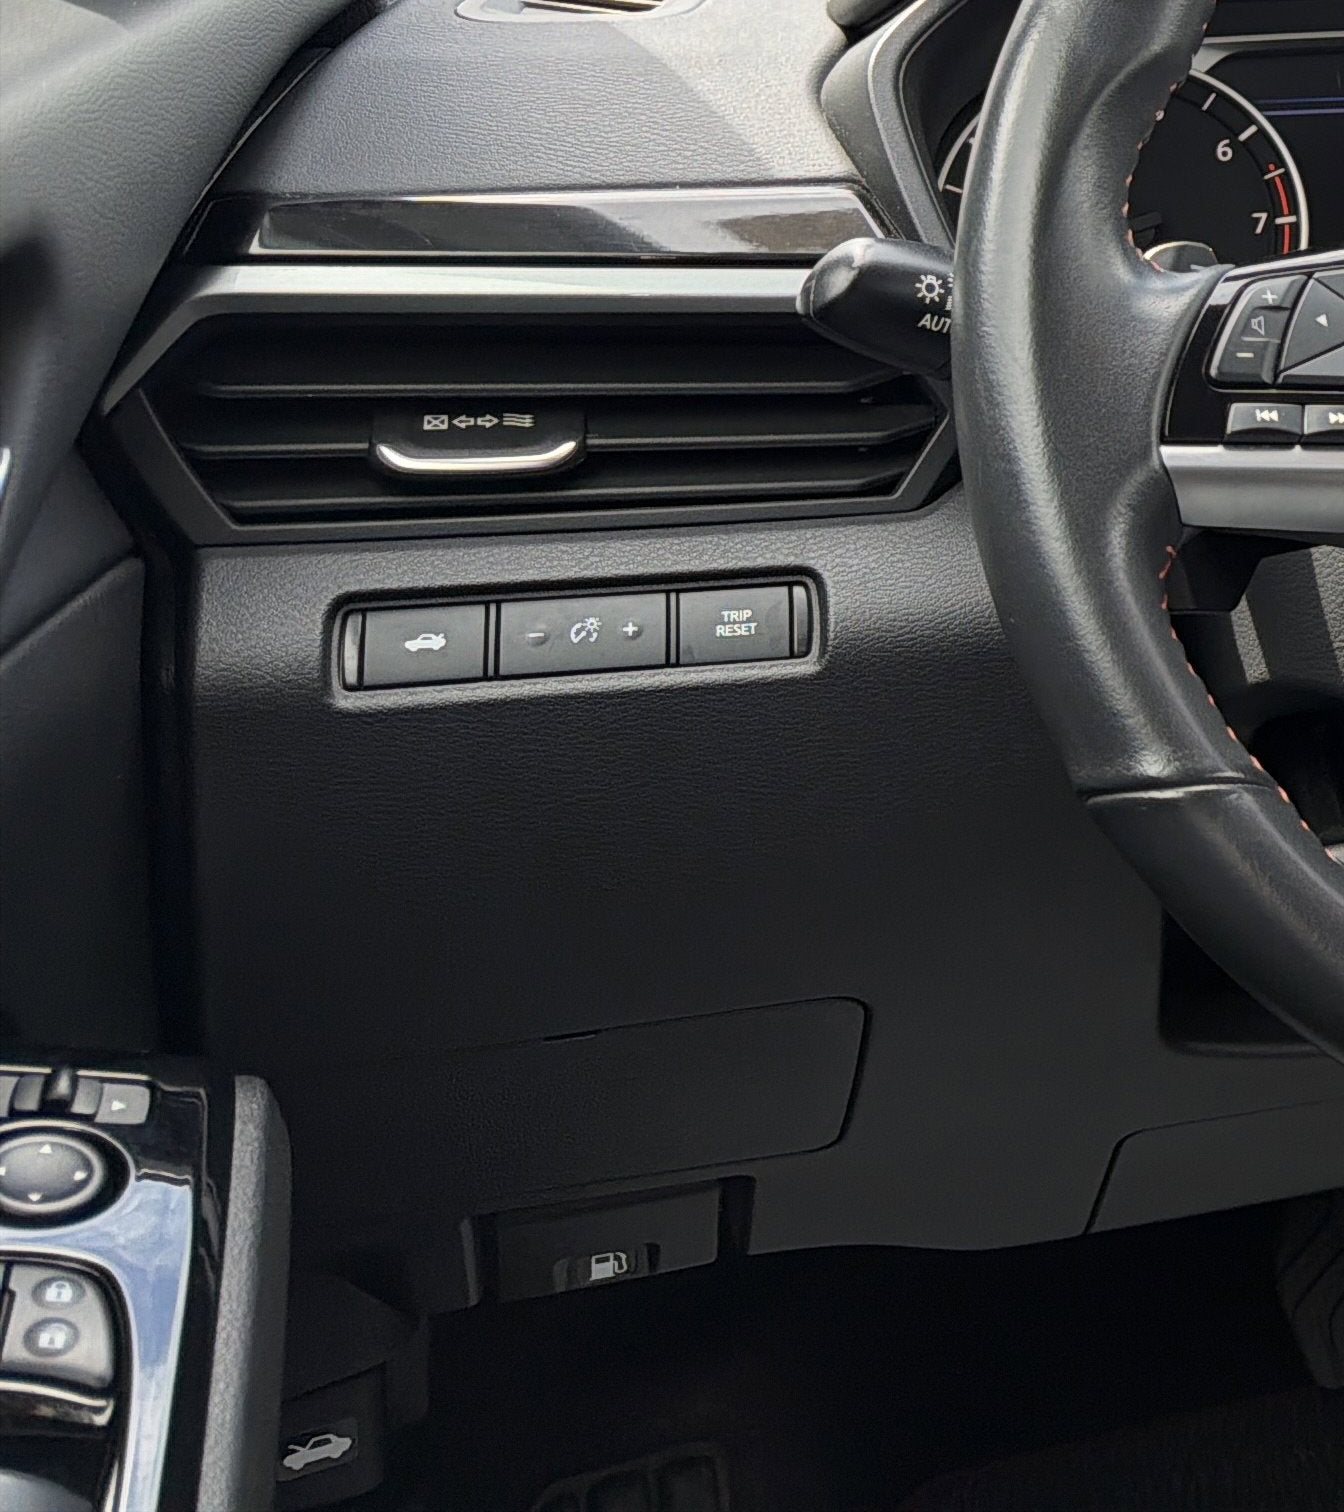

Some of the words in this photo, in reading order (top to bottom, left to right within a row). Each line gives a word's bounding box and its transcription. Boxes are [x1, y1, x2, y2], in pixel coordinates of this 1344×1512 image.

[1216, 139, 1233, 162] 6
[1251, 212, 1268, 235] 7
[917, 313, 951, 334] AUT
[720, 608, 752, 623] TRIP
[715, 621, 757, 637] RESET
